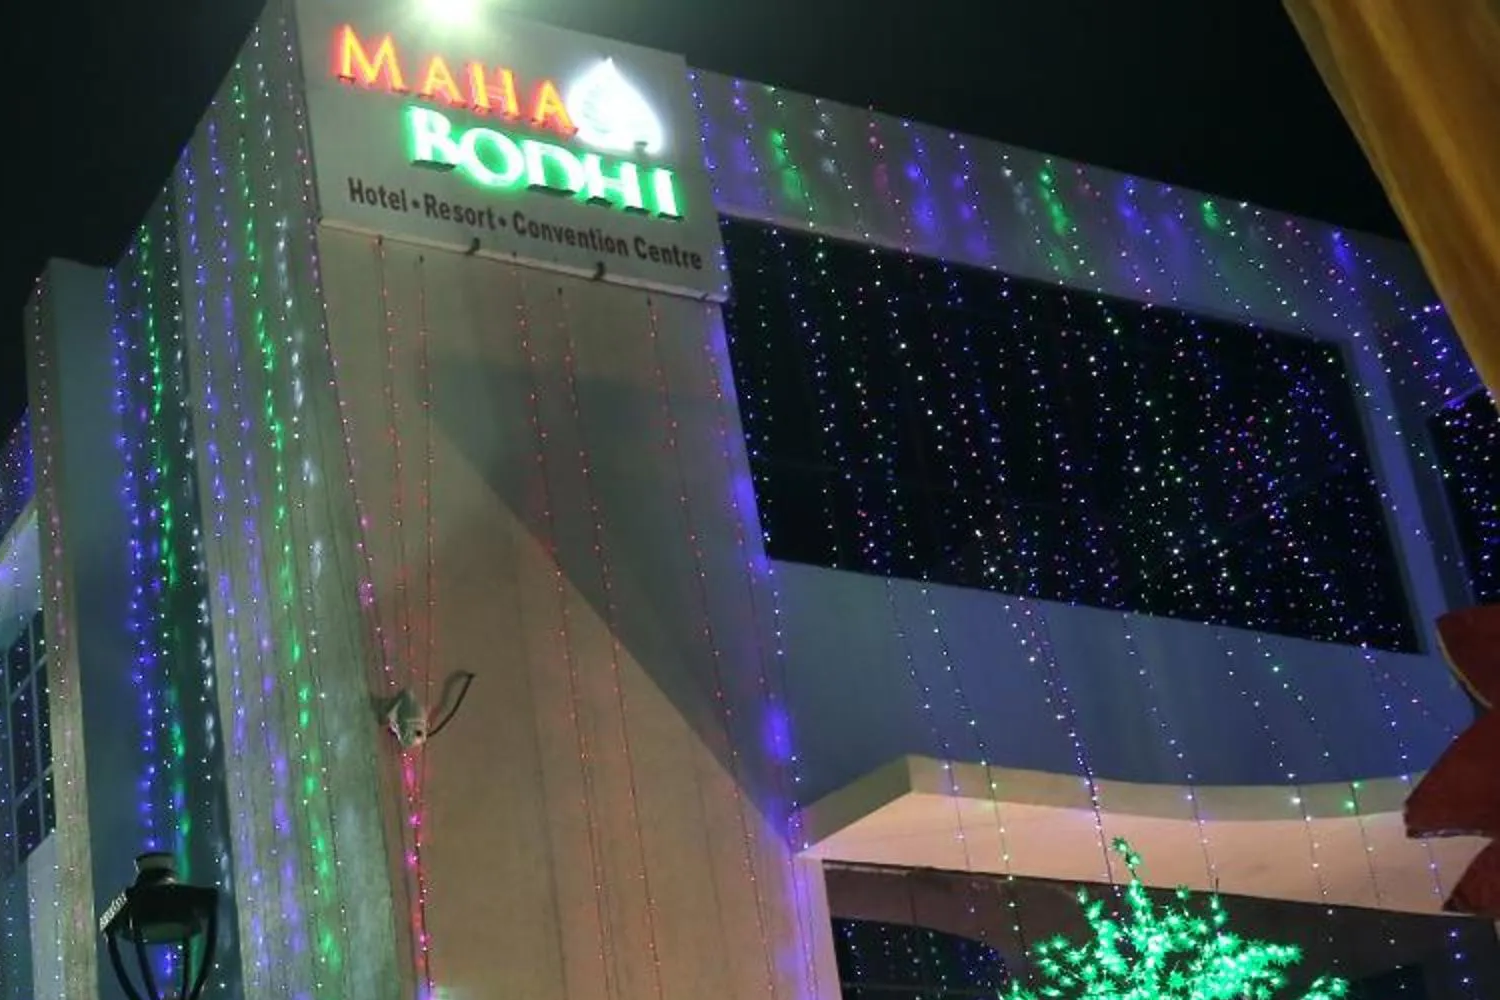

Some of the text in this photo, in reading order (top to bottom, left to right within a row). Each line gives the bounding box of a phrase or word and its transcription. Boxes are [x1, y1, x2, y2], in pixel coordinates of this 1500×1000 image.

[334, 24, 577, 136] MAHA
[347, 177, 703, 270] Hotel Resort Convention Centre
